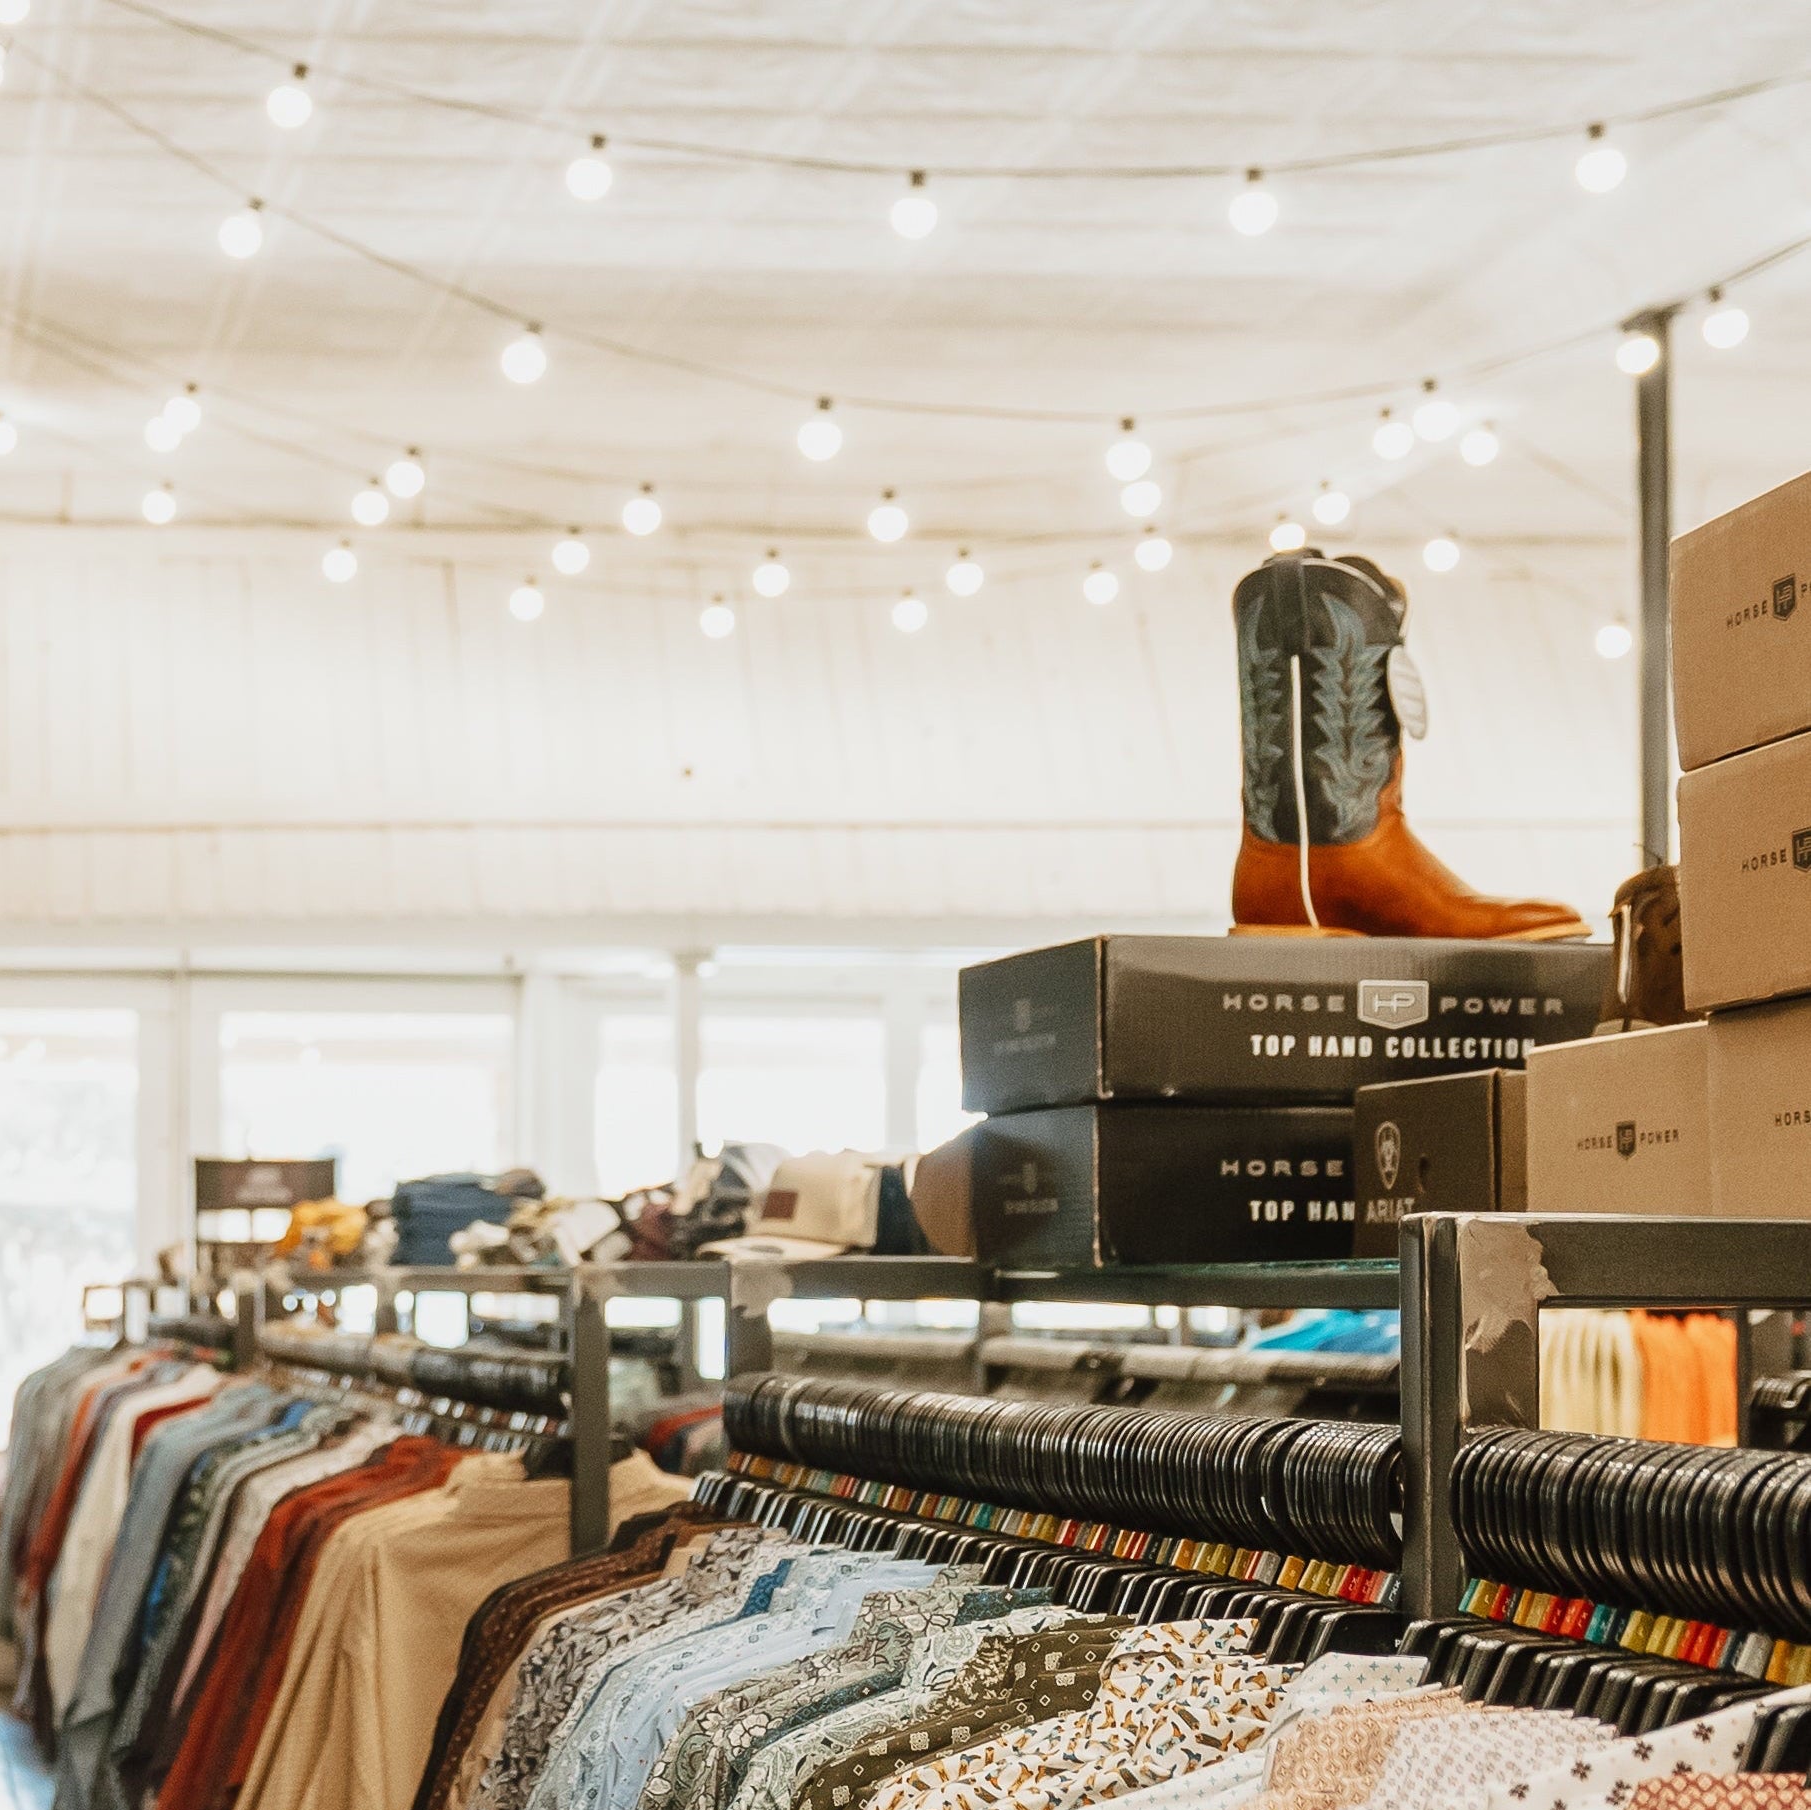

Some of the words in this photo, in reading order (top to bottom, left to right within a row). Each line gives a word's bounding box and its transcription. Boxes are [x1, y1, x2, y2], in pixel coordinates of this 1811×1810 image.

[1741, 848, 1787, 872] HORSE
[1222, 993, 1345, 1013] HORSE
[1440, 996, 1564, 1016] POWER
[1250, 1034, 1296, 1057] TOP
[1308, 1035, 1373, 1058] HAND
[1385, 1036, 1536, 1060] COLLECTION
[1774, 1110, 1811, 1127] HORS
[1640, 1129, 1680, 1145] POWER
[1220, 1160, 1344, 1177] HORSE
[1249, 1200, 1294, 1223] TOP
[1307, 1201, 1356, 1222] HAN
